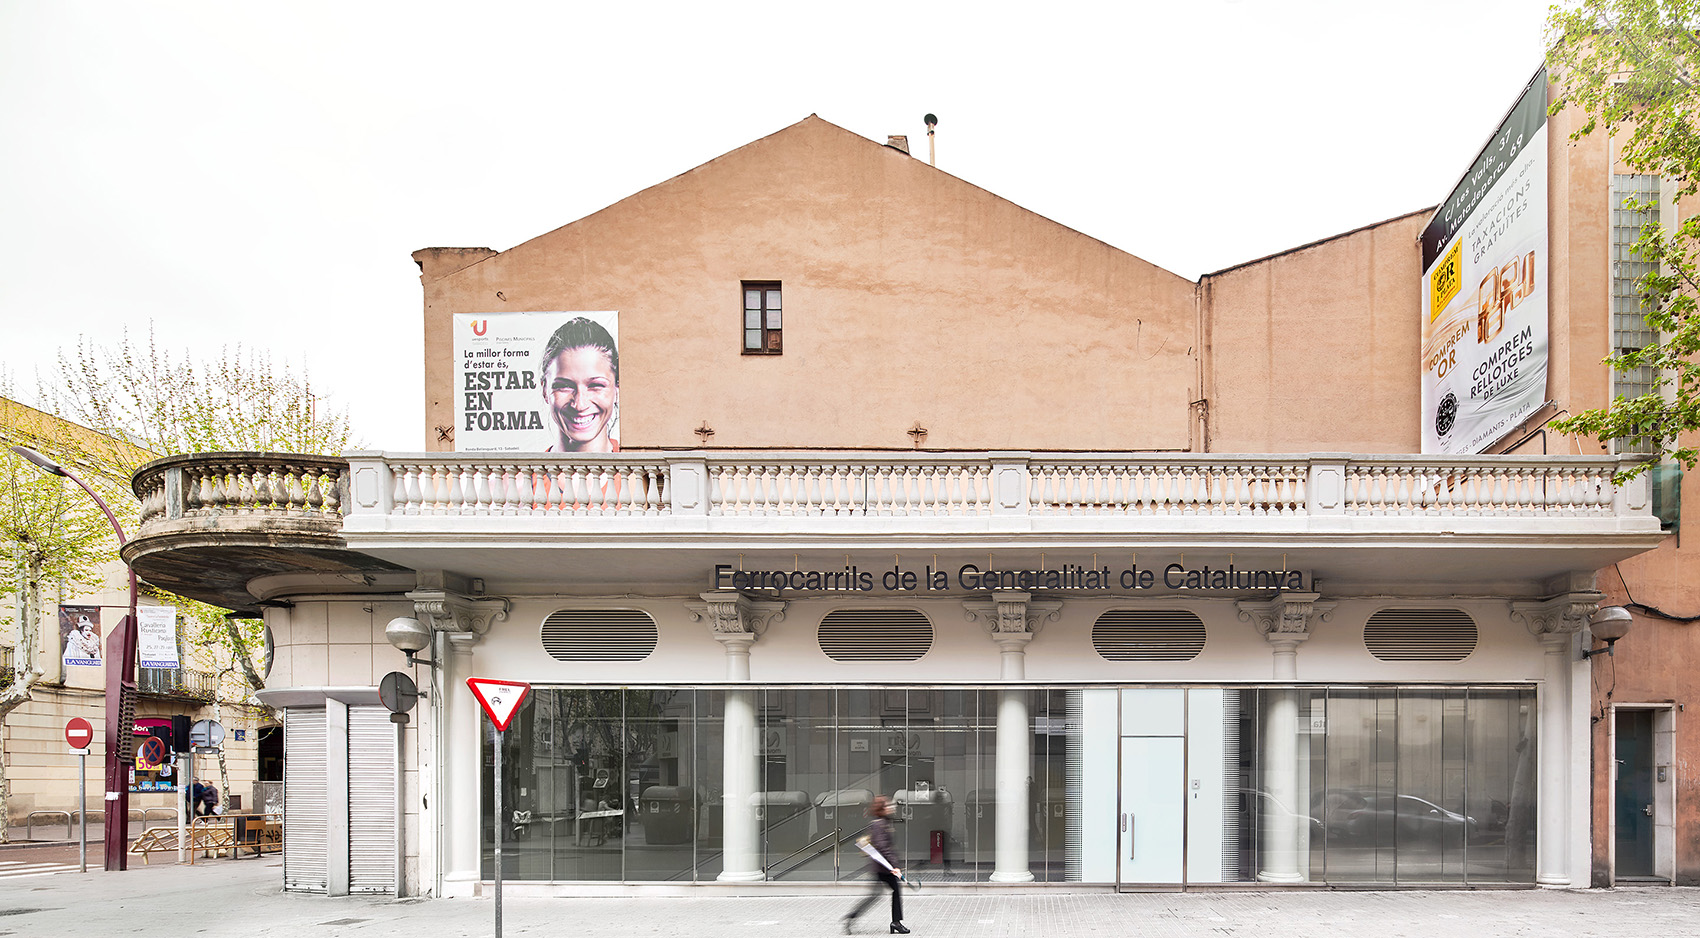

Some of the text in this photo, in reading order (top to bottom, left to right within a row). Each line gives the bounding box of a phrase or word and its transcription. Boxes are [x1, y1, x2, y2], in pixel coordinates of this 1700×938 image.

[1456, 187, 1470, 208] Les
[1471, 155, 1497, 186] Valls,
[1498, 126, 1513, 152] 37
[1435, 133, 1524, 252] Av. Matadepera, 69
[1471, 178, 1532, 253] TAXACIONS
[464, 348, 530, 358] La millor forma
[1428, 320, 1471, 372] COMPREM
[1472, 324, 1532, 382] COMPREM
[464, 359, 509, 369] d'estar és,
[1437, 348, 1457, 379] OR
[1470, 340, 1533, 400] RELLOTGES
[464, 371, 537, 391] ESTAR
[1483, 367, 1519, 401] DE LUXE
[464, 392, 493, 411] EN
[465, 411, 544, 431] FORMA
[1472, 419, 1505, 447] DIAMANTS
[1509, 402, 1531, 422] PLATA
[715, 563, 1304, 593] Ferrocarrils de la Generalitat de Catalunya
